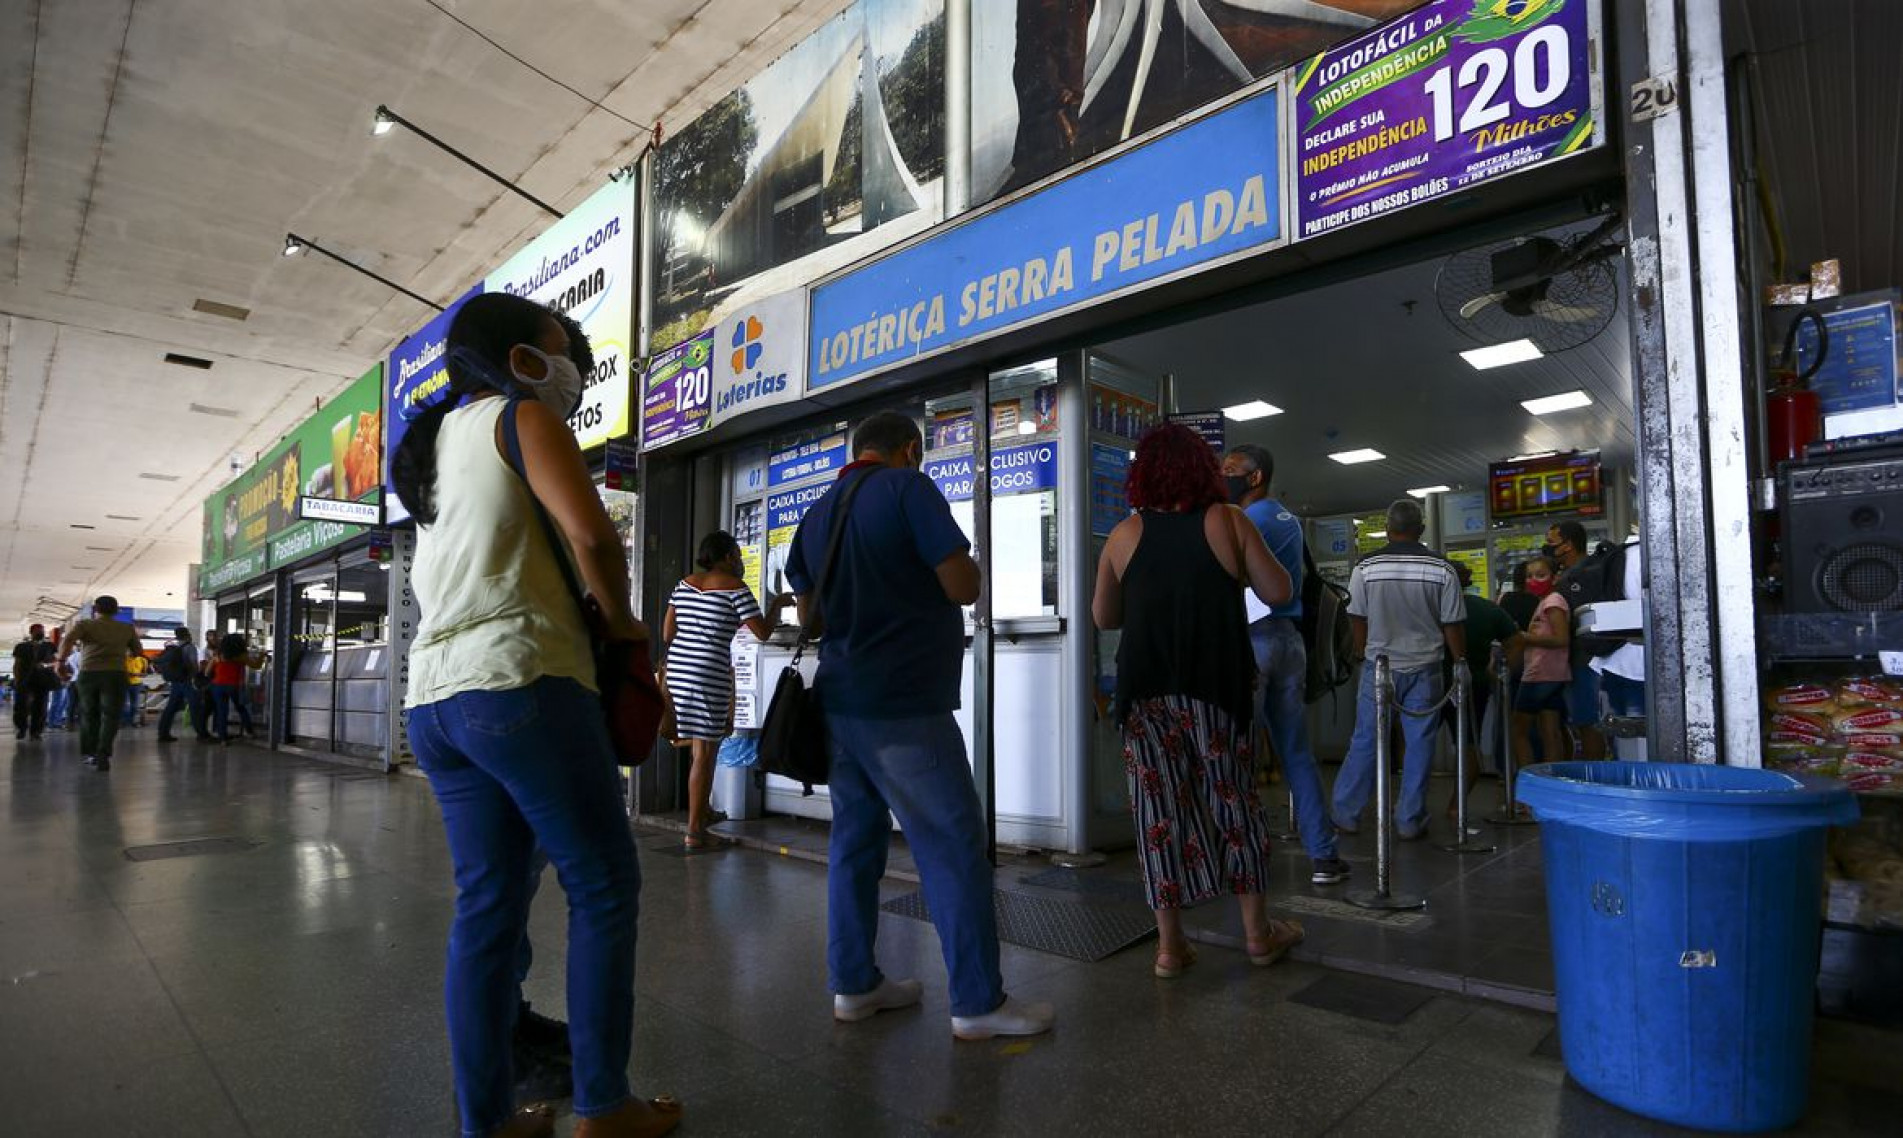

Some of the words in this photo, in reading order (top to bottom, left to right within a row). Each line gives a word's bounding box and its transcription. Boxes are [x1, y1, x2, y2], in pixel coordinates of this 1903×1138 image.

[1318, 21, 1418, 87] LOTOFÁCIL
[1424, 14, 1443, 31] DA
[1315, 35, 1447, 115] INDEPENDÊNCIA
[1424, 24, 1569, 142] 120
[1303, 116, 1428, 177] INDEPENDÊNCIA
[1305, 120, 1357, 150] DECLARE
[1360, 109, 1385, 129] SUA
[1469, 109, 1577, 154] Milhões
[1310, 191, 1317, 202] O
[1357, 169, 1379, 187] NÃO
[1381, 152, 1429, 178] ACUMULA
[1466, 152, 1510, 173] SORTEIO
[1512, 145, 1532, 157] DIA
[1471, 170, 1484, 181] DE
[1305, 208, 1351, 235] PARTICIPE
[1351, 203, 1370, 220] DOS
[1371, 191, 1410, 214] NOSSOS
[1411, 177, 1449, 201] BOLÕES
[958, 246, 1074, 327] SERRA
[1091, 174, 1268, 282] PELADA
[549, 267, 605, 313] CARIA
[583, 353, 617, 391] EROX
[674, 366, 709, 413] 120
[716, 371, 787, 414] Loterias
[570, 402, 602, 433] ETOS
[928, 461, 972, 480] CAIXA
[990, 447, 1053, 470] CLUSIVO
[990, 470, 1034, 490] OGOS
[306, 500, 375, 516] TABACARIA
[769, 494, 795, 510] CAIXA
[778, 509, 800, 525] PARA
[274, 528, 312, 562] Pastelaria
[401, 620, 410, 640] DE
[400, 653, 409, 684] LAN
